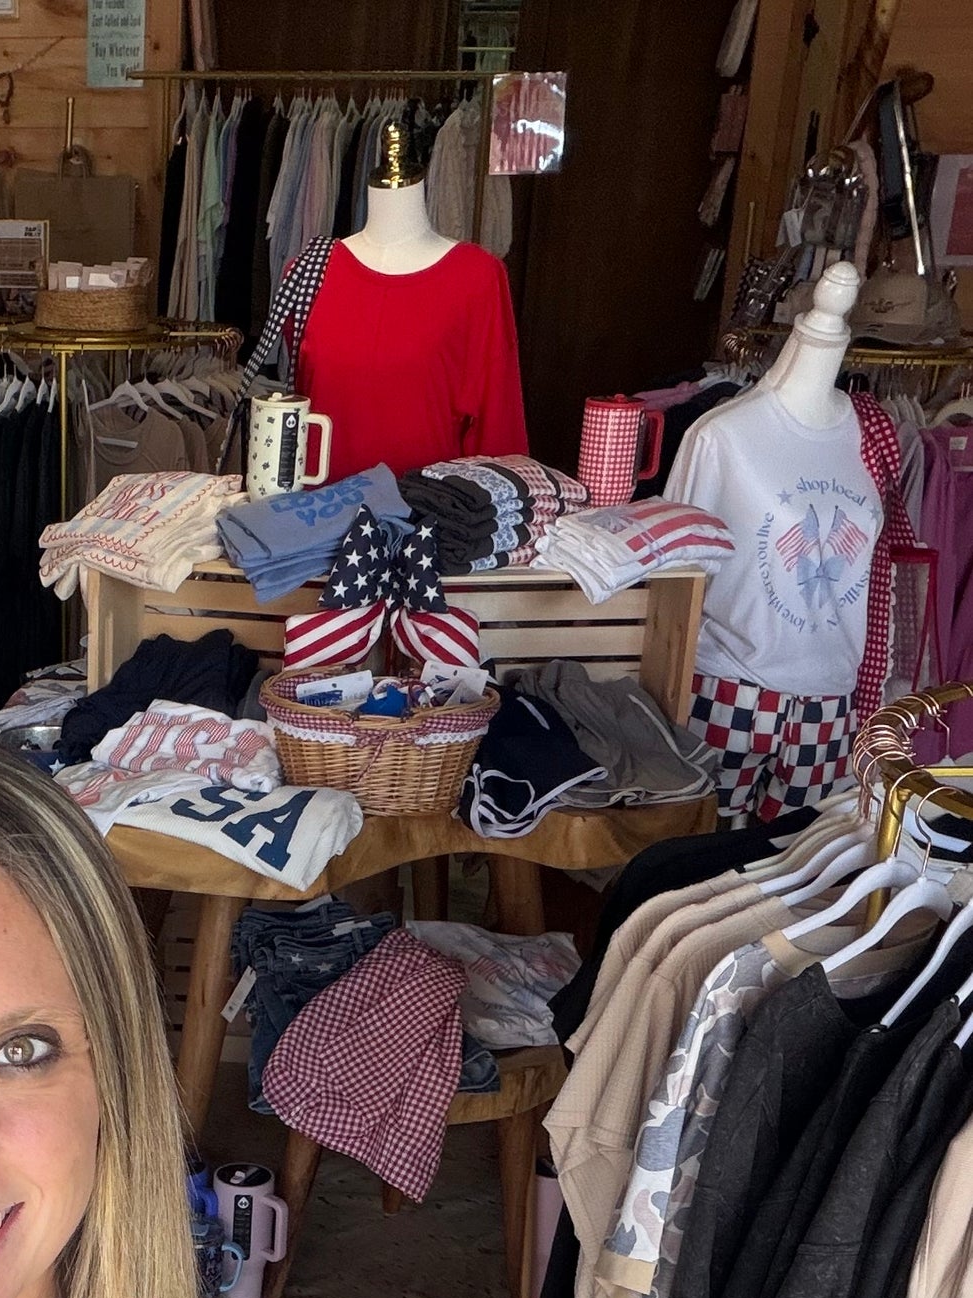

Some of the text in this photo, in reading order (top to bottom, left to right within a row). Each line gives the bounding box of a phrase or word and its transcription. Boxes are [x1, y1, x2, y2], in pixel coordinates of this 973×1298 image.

[295, 488, 365, 527] YOU
[796, 477, 867, 507] shop local
[756, 511, 806, 633] love where you live
